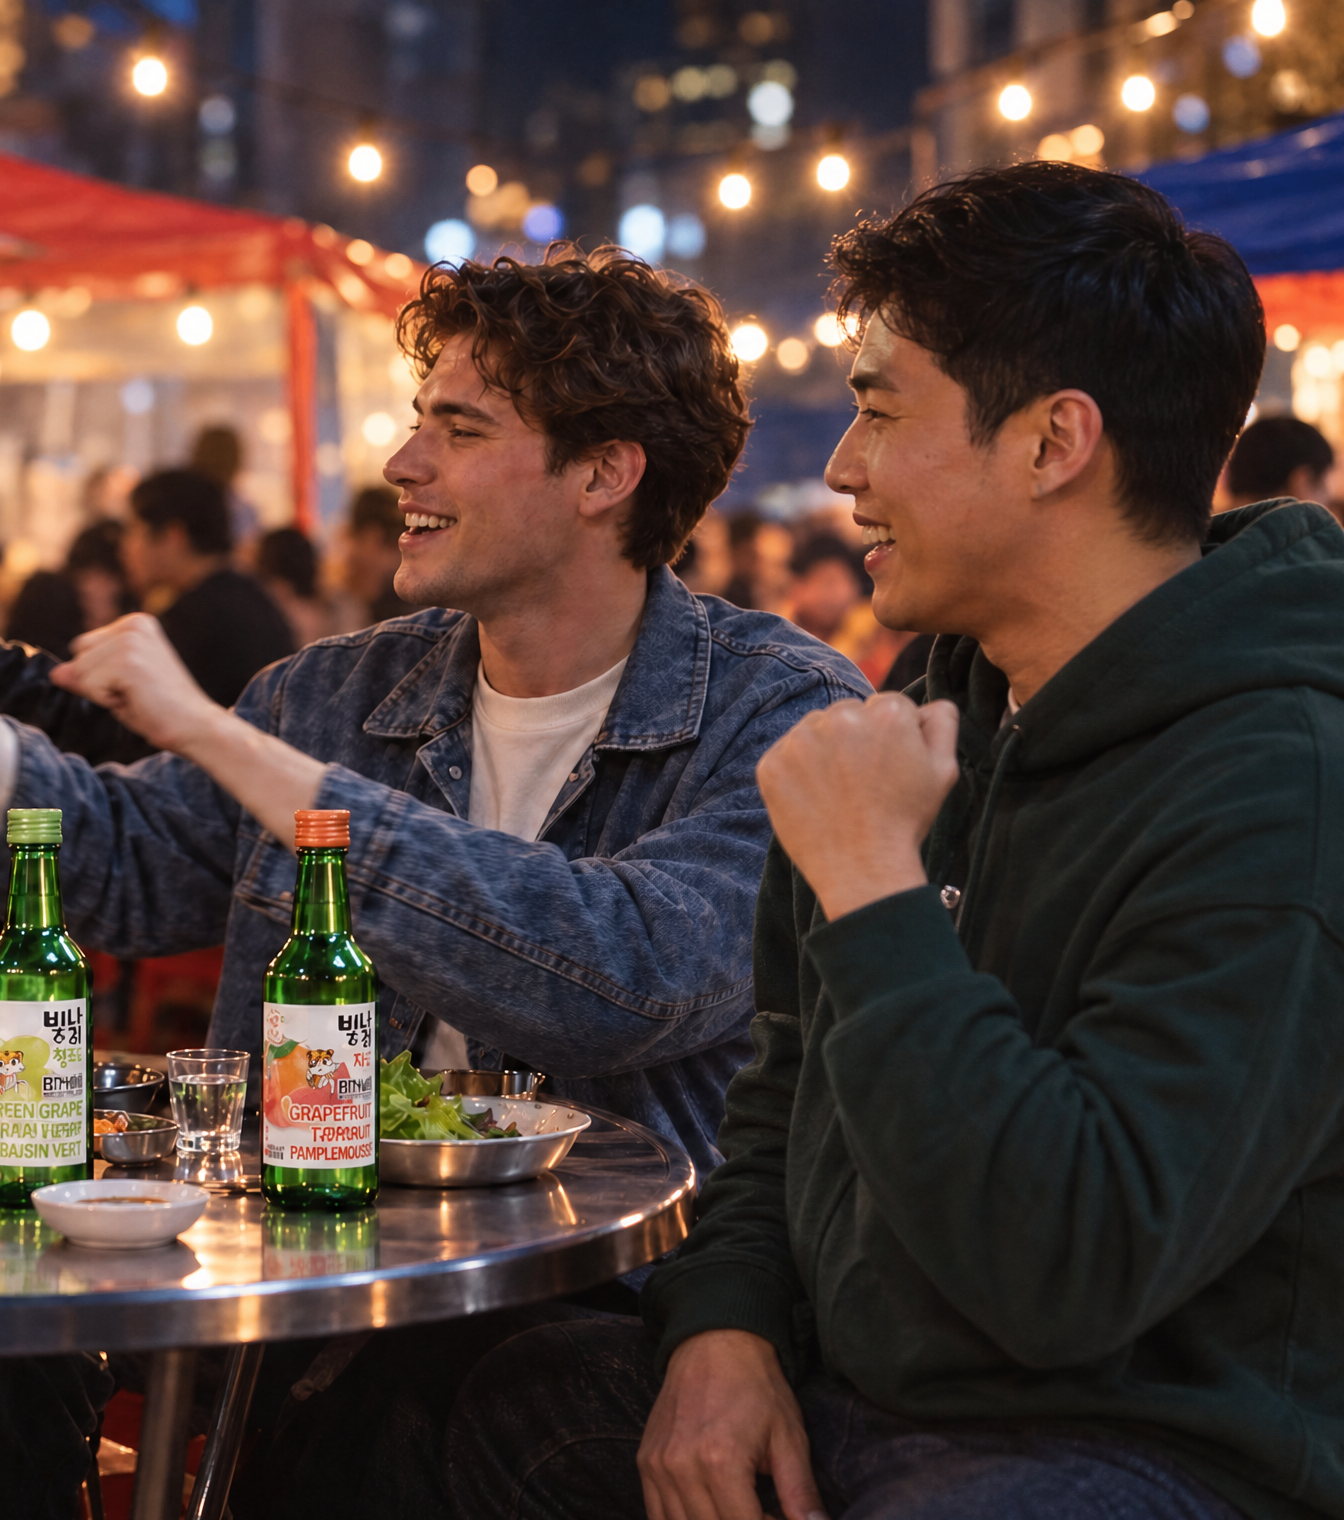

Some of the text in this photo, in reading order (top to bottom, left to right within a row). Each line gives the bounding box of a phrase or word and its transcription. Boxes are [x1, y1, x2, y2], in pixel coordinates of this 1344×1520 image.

[39, 1100, 83, 1119] GRAPE
[289, 1102, 372, 1121] GRAPEFRUIT
[52, 1140, 82, 1159] VERT
